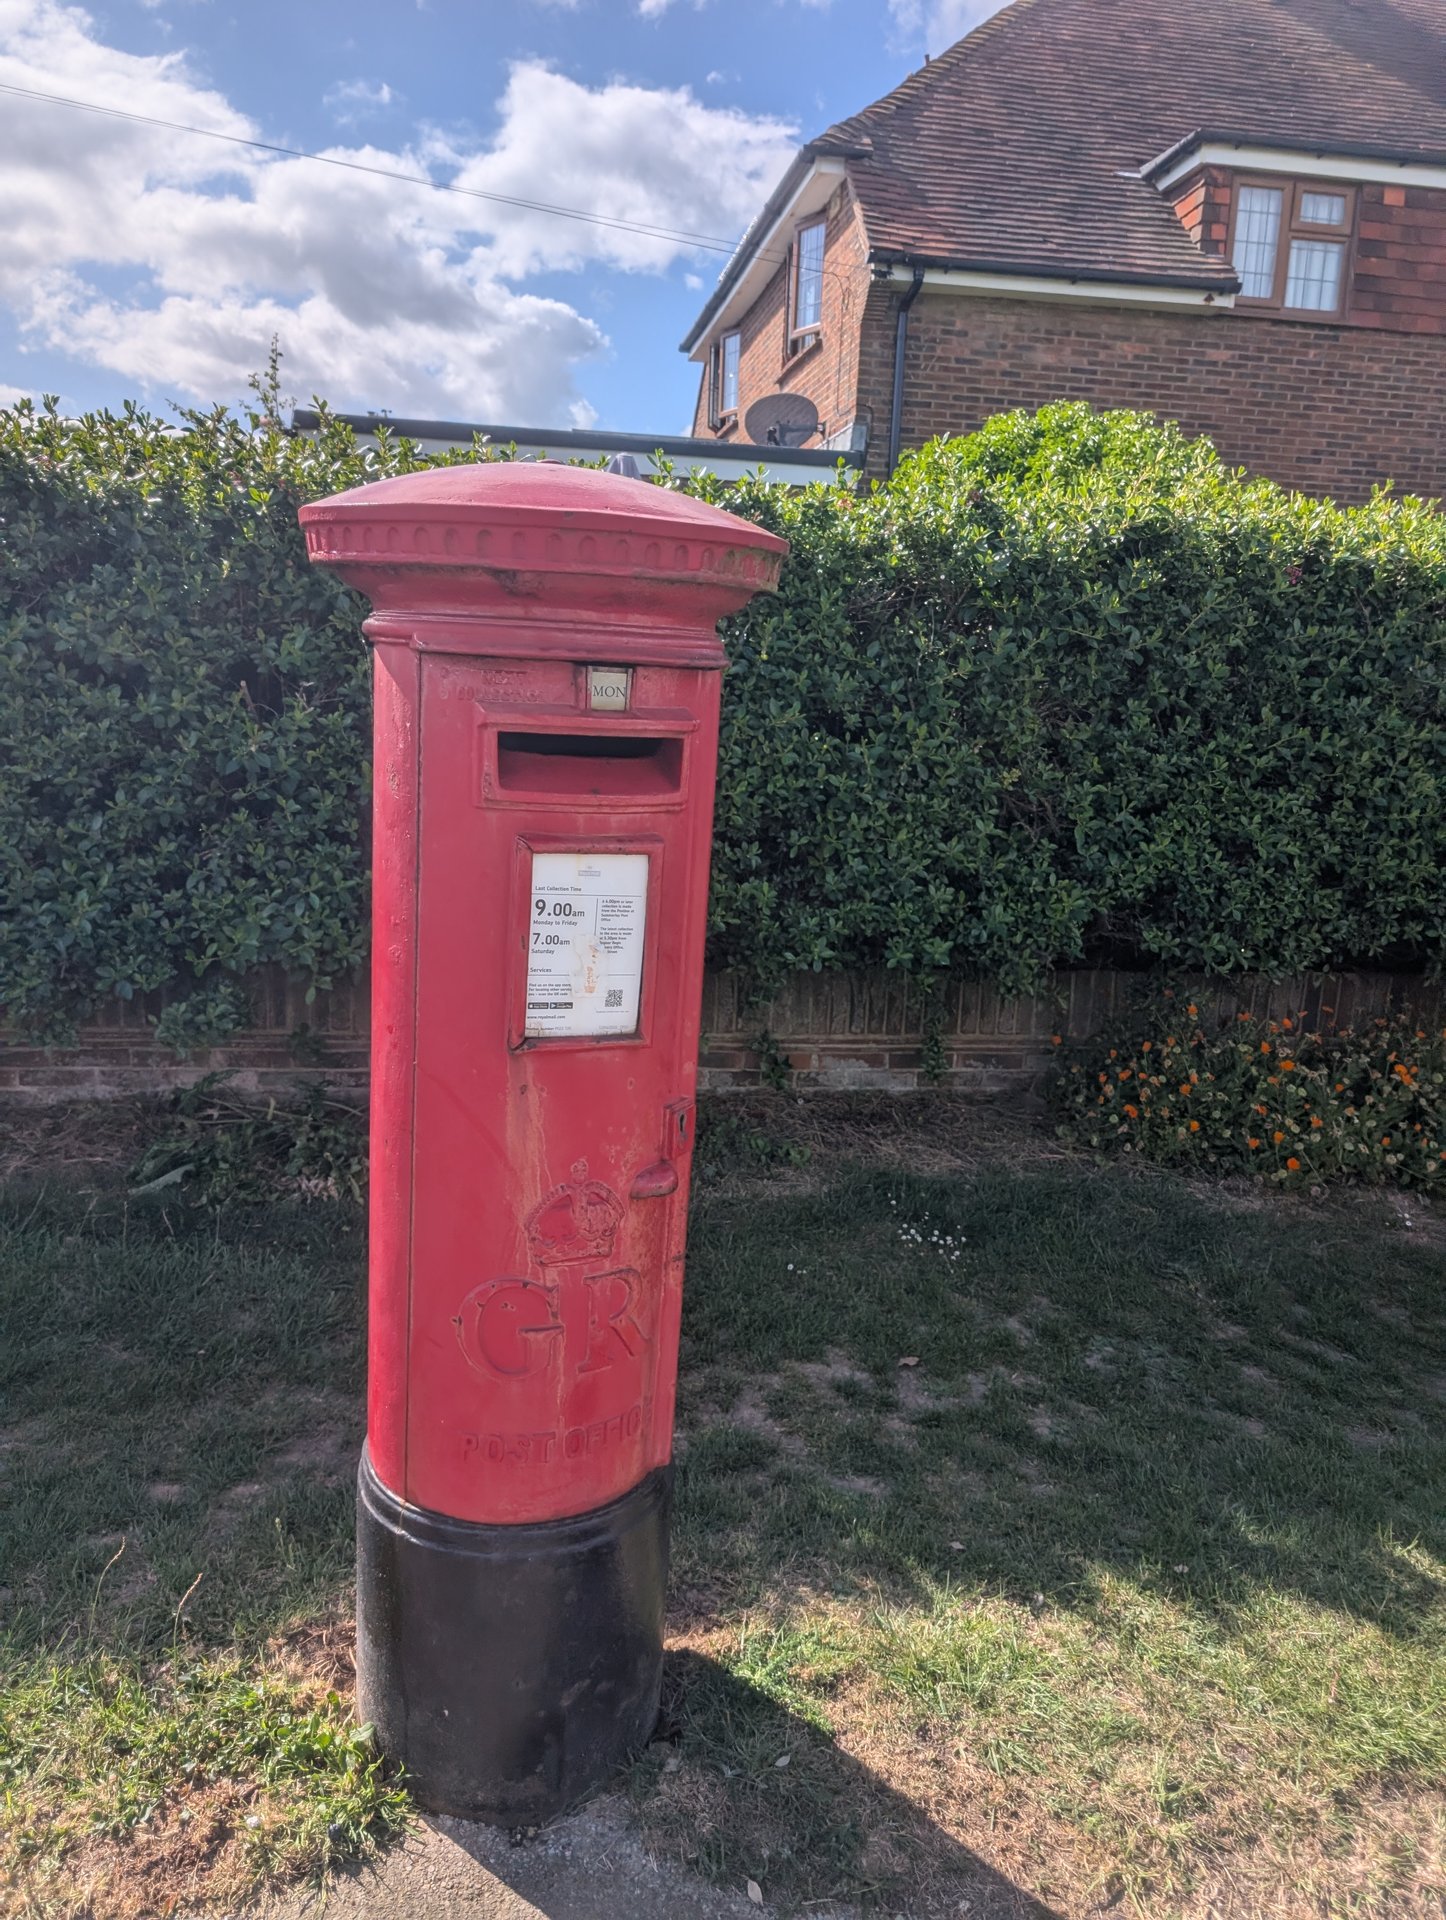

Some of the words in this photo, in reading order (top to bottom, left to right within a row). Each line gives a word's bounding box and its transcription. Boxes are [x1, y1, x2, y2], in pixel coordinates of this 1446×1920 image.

[592, 684, 627, 698] MON
[535, 899, 585, 917] 9.00am
[532, 932, 570, 945] 7.00am
[462, 1430, 557, 1464] POST
